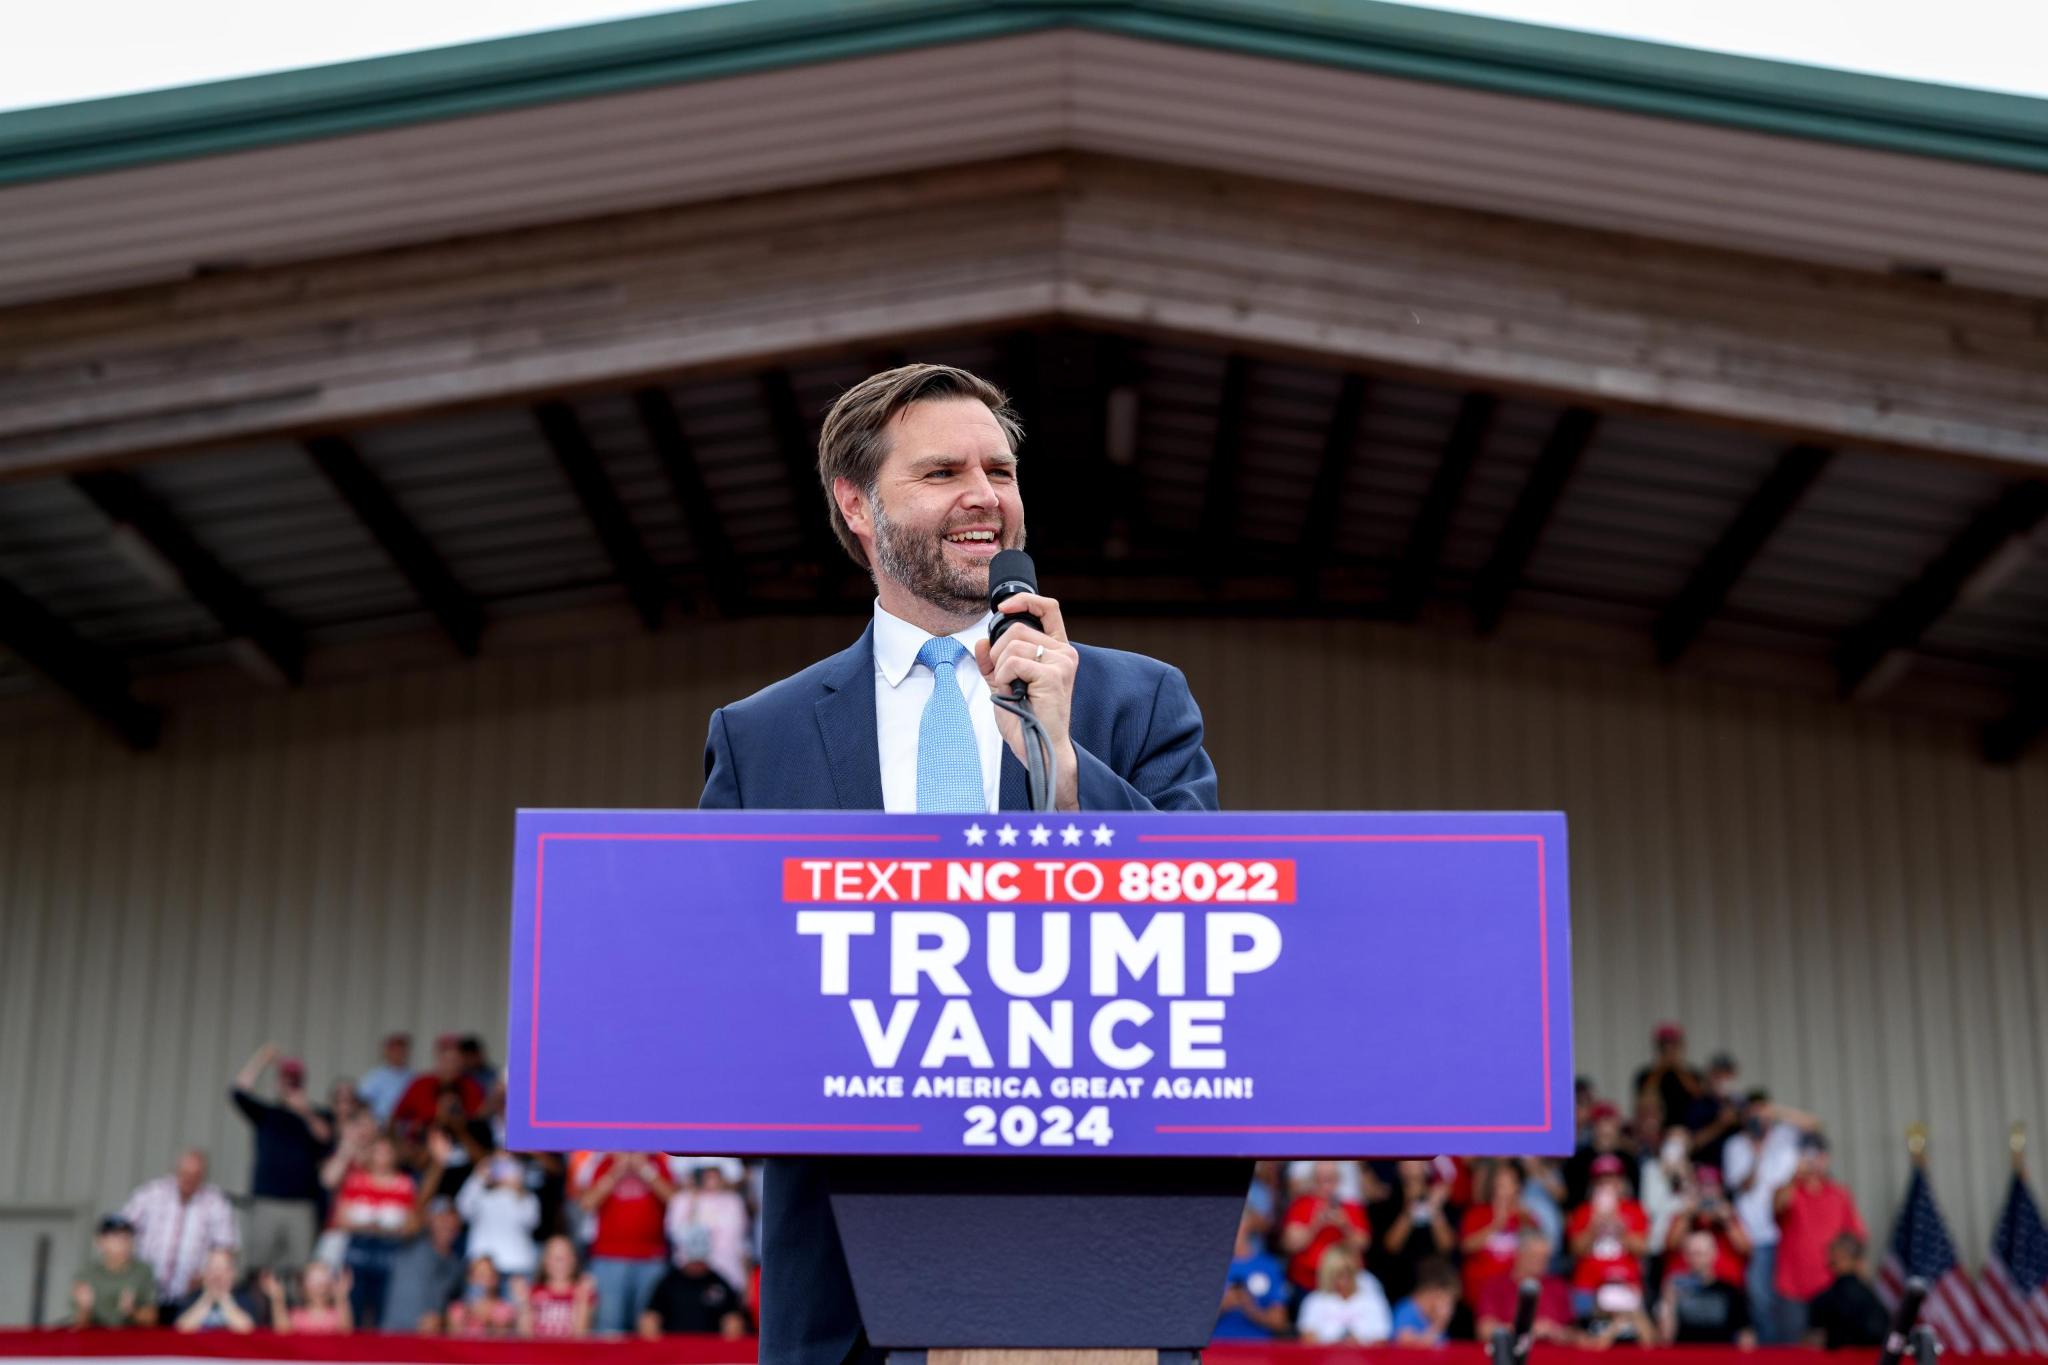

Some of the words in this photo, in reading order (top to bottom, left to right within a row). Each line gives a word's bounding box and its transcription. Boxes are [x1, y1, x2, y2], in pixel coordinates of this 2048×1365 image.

[802, 862, 931, 902] TEXT
[947, 863, 1020, 902] NC
[1035, 863, 1103, 902] TO
[1119, 863, 1278, 902] 88022
[797, 911, 1283, 997] TRUMP
[850, 999, 1227, 1070] VANCE
[824, 1076, 904, 1098] MAKE
[912, 1076, 1041, 1098] AMERICA
[1051, 1077, 1144, 1099] GREAT
[1152, 1077, 1254, 1099] AGAIN!
[963, 1105, 1113, 1147] 2024
